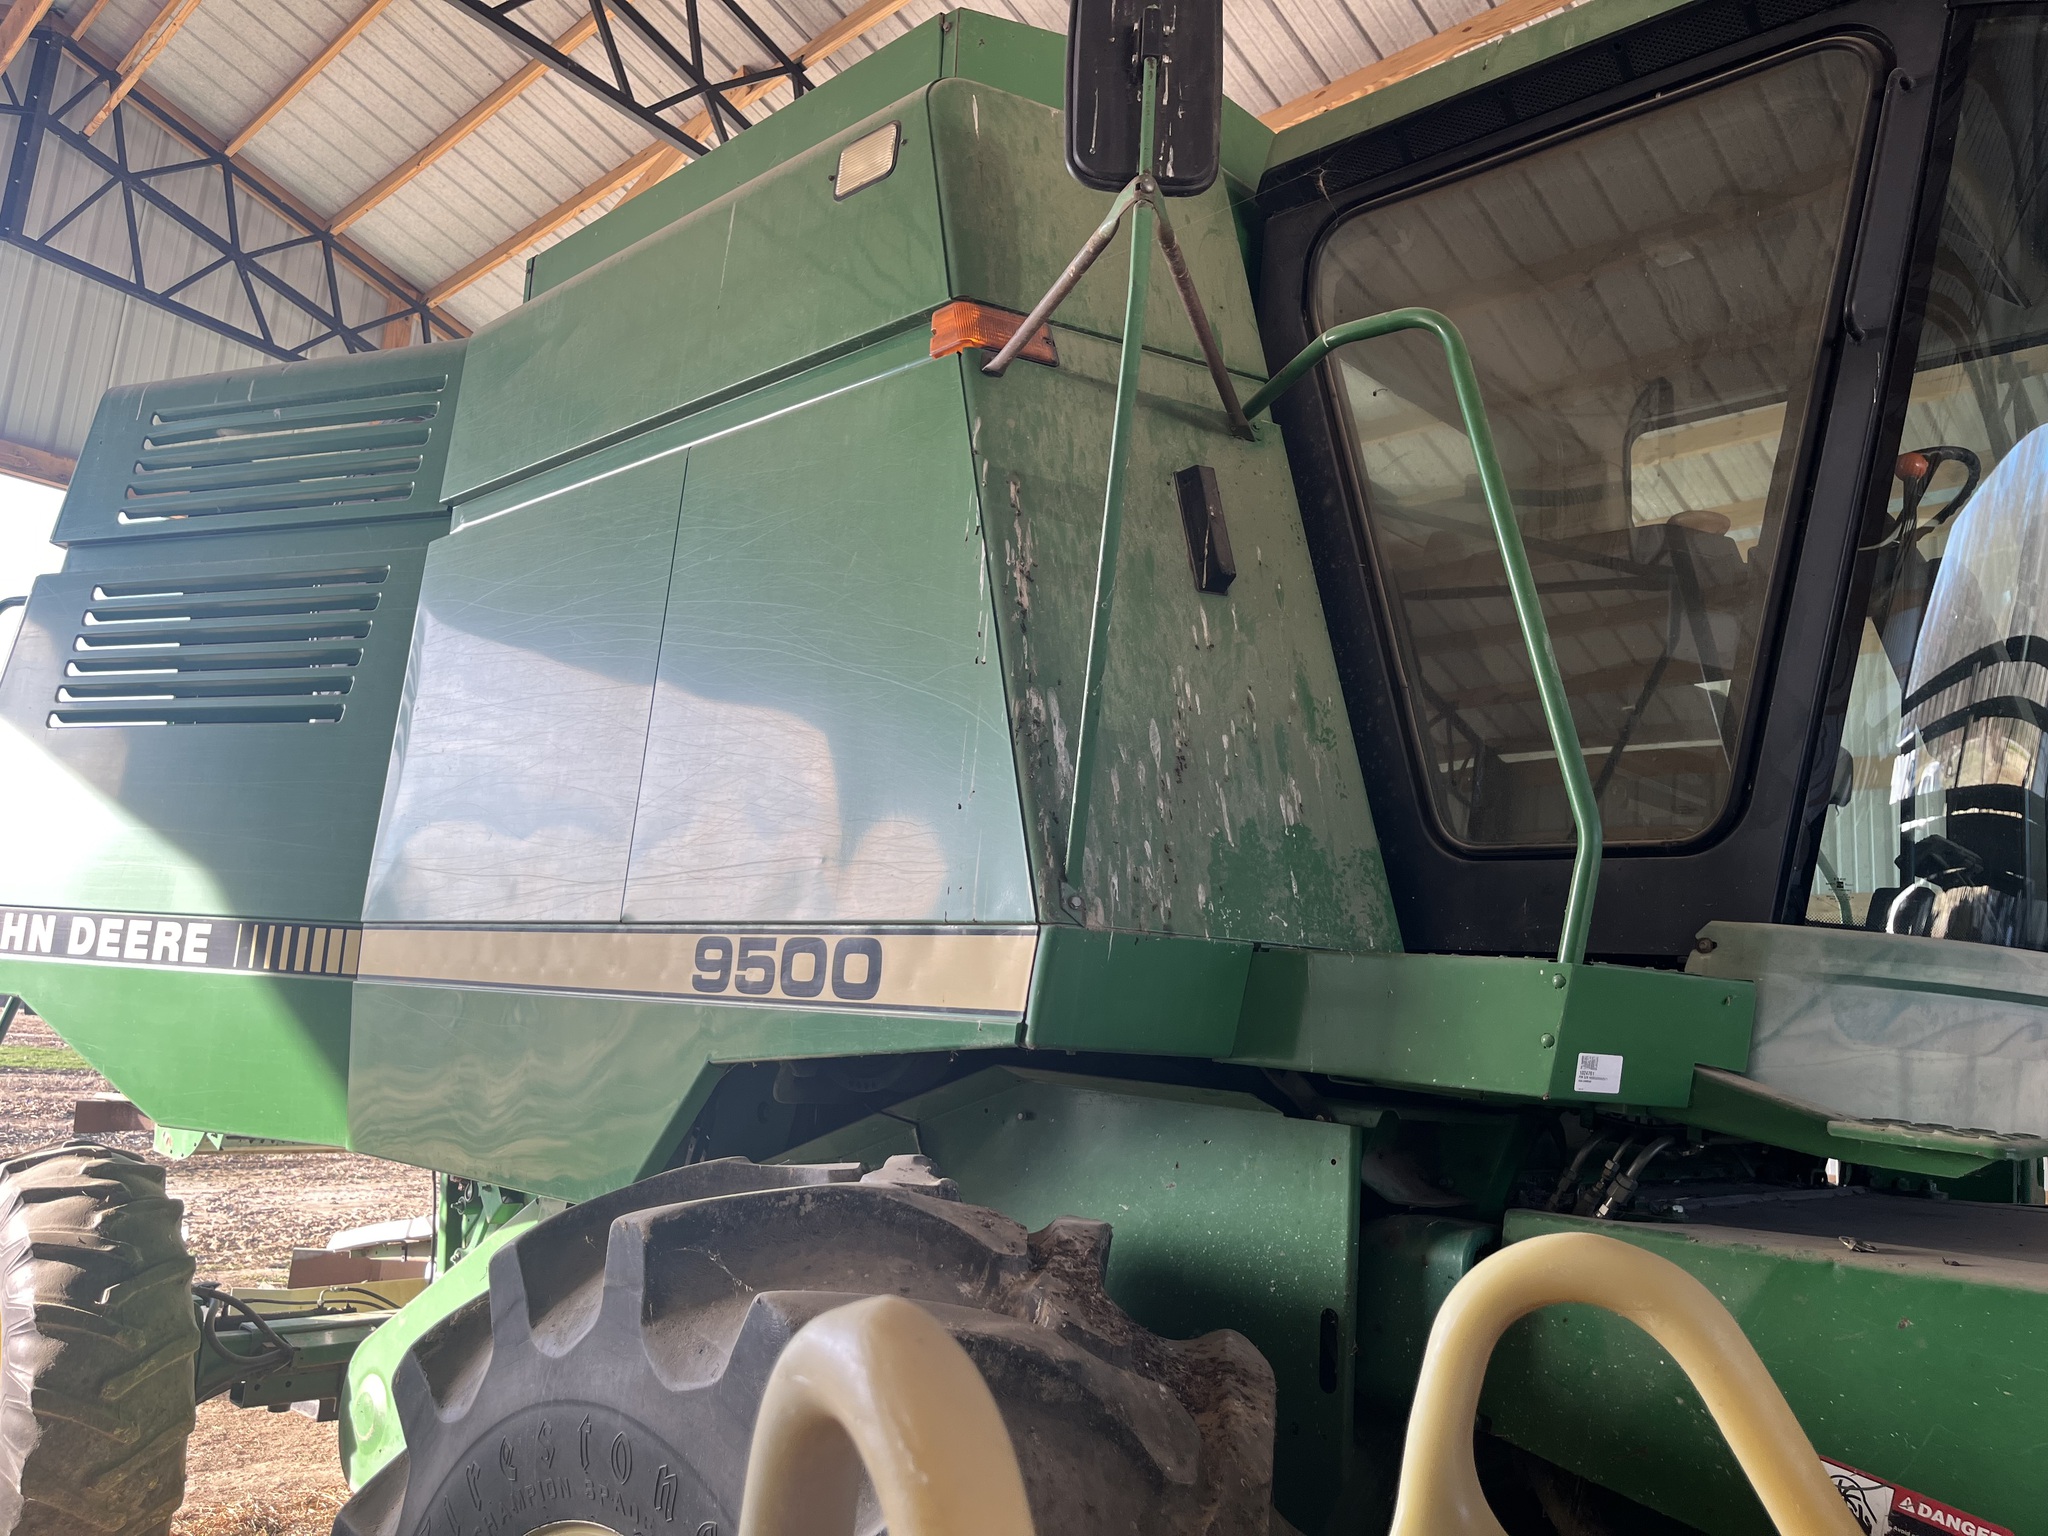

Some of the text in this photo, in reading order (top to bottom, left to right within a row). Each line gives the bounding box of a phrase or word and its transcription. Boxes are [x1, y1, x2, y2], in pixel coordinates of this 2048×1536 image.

[0, 912, 212, 963] HN DEERE
[692, 936, 882, 1000] 9500
[1917, 1502, 2003, 1536] DANGE
